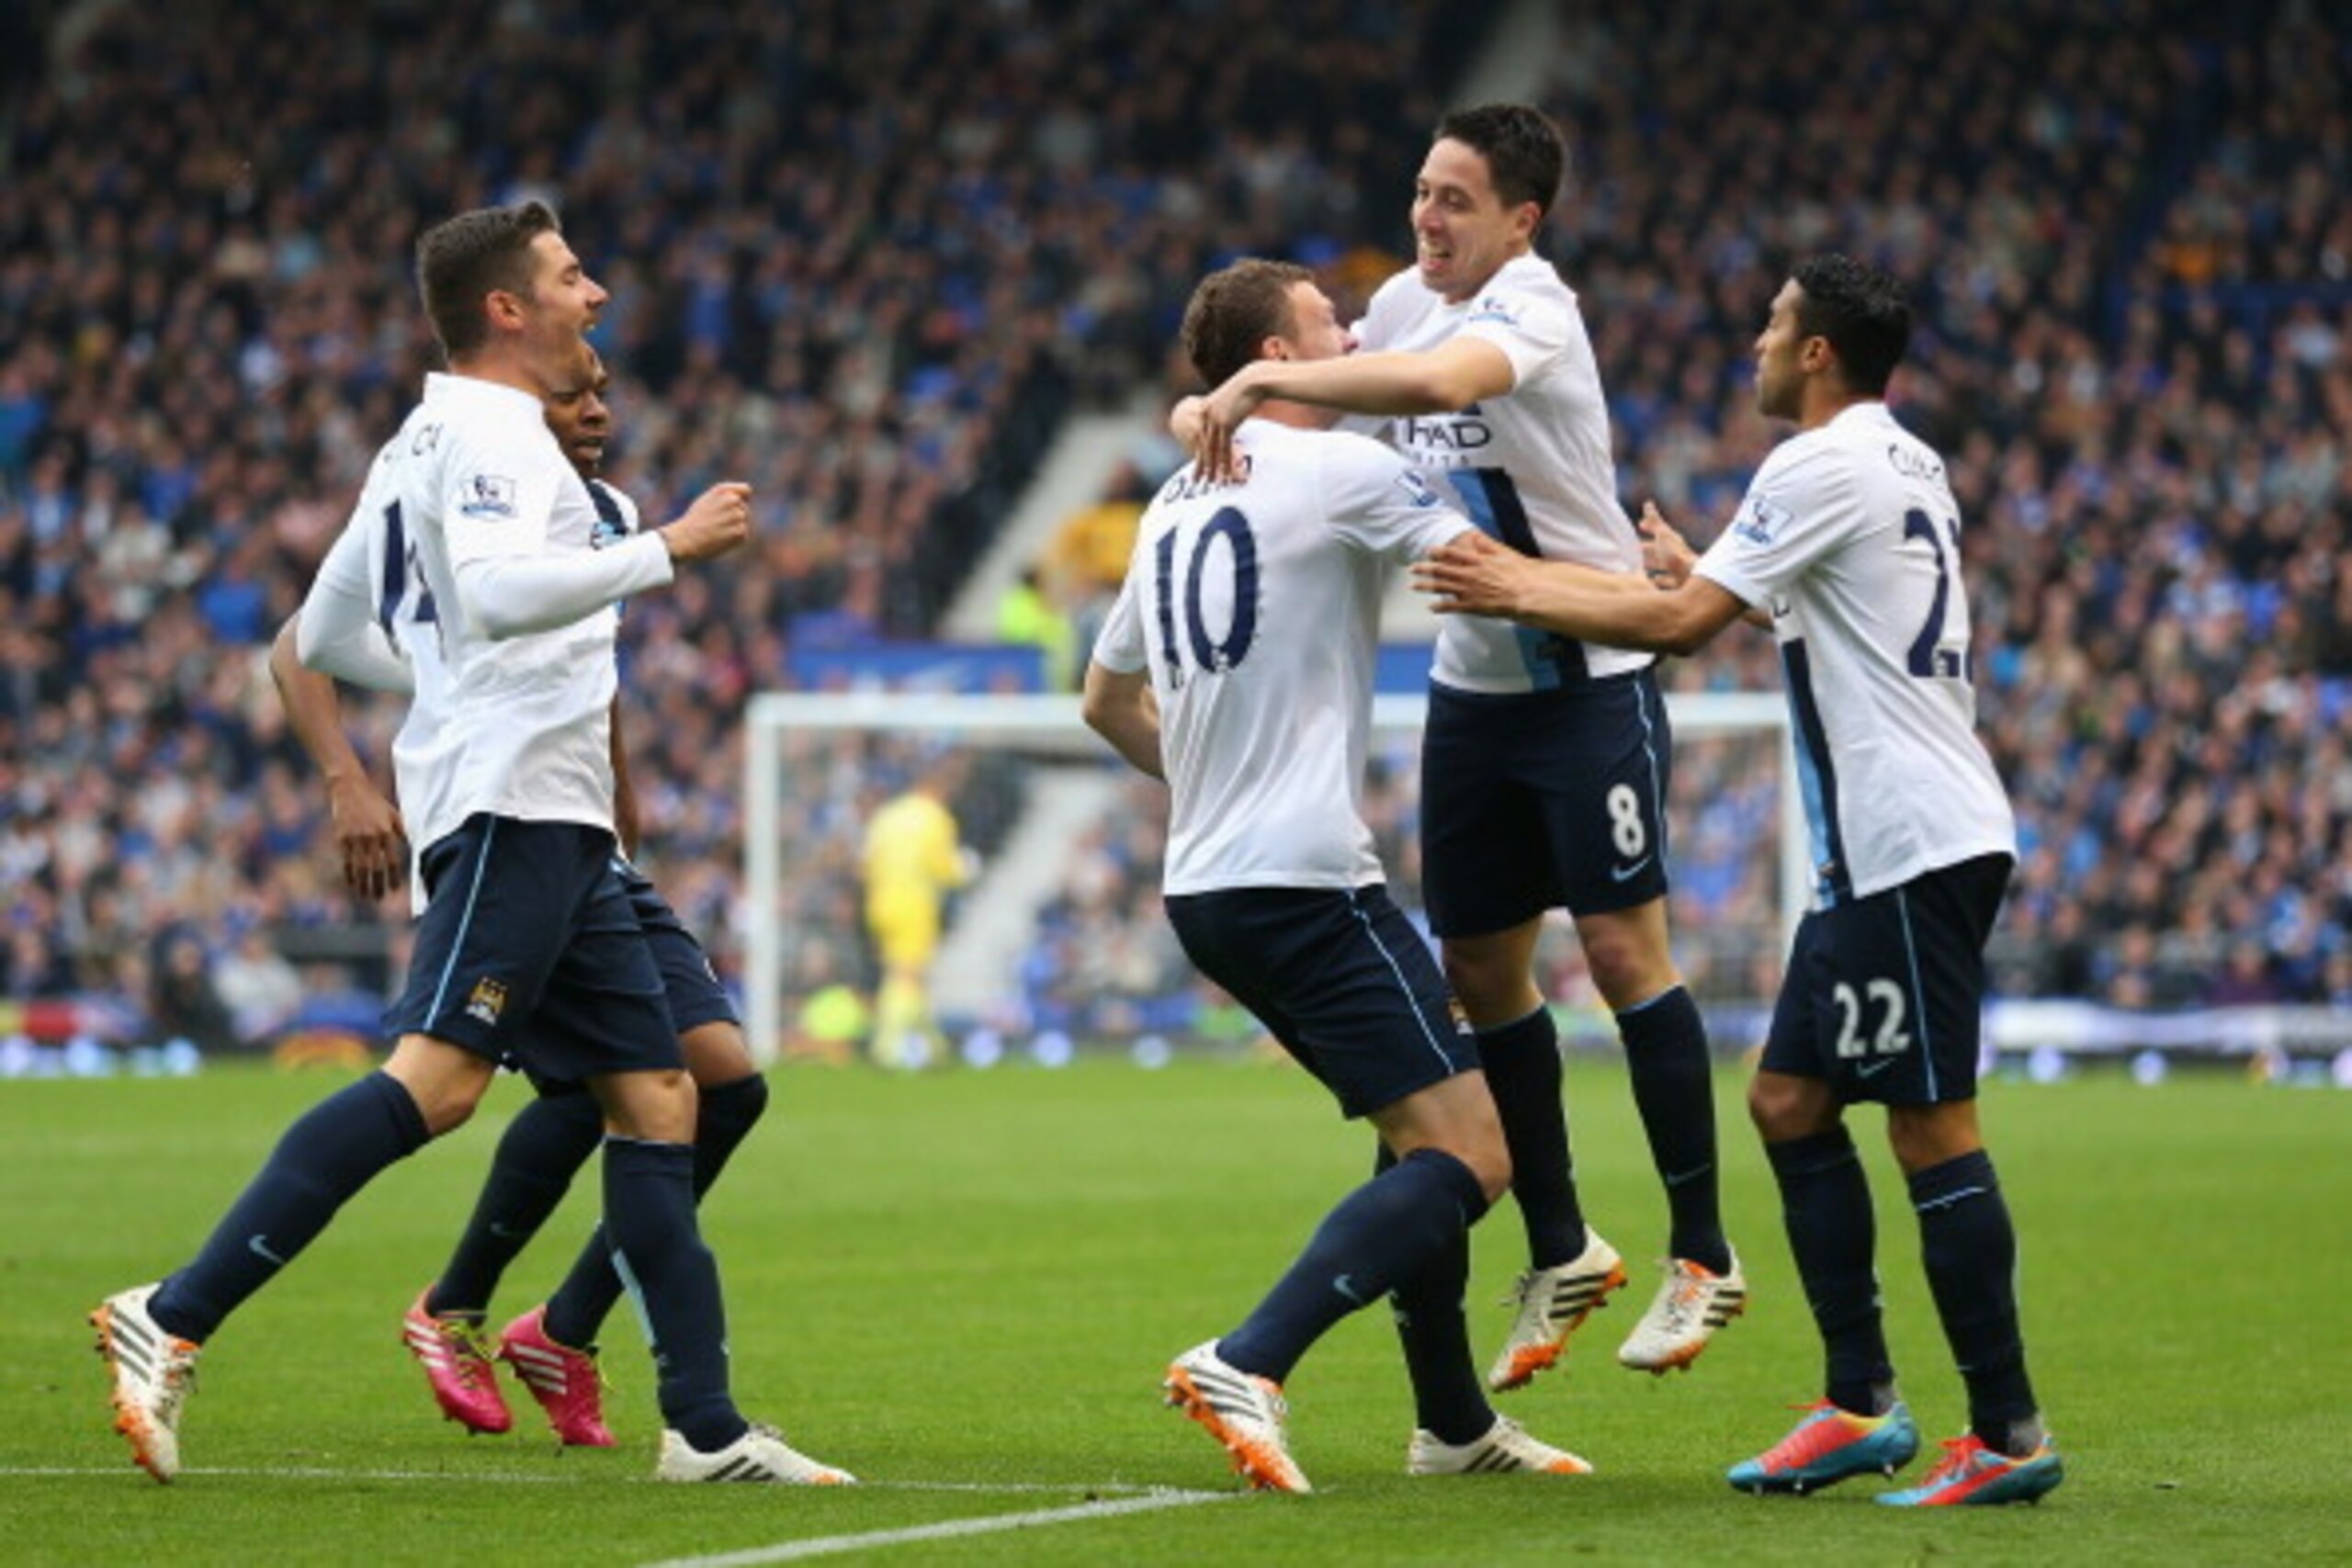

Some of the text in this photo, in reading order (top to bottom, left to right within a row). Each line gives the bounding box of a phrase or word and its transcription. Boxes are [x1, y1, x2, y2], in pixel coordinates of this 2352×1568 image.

[1155, 506, 1261, 689] 10
[1607, 784, 1645, 858] 8
[1832, 978, 1911, 1057] 22
